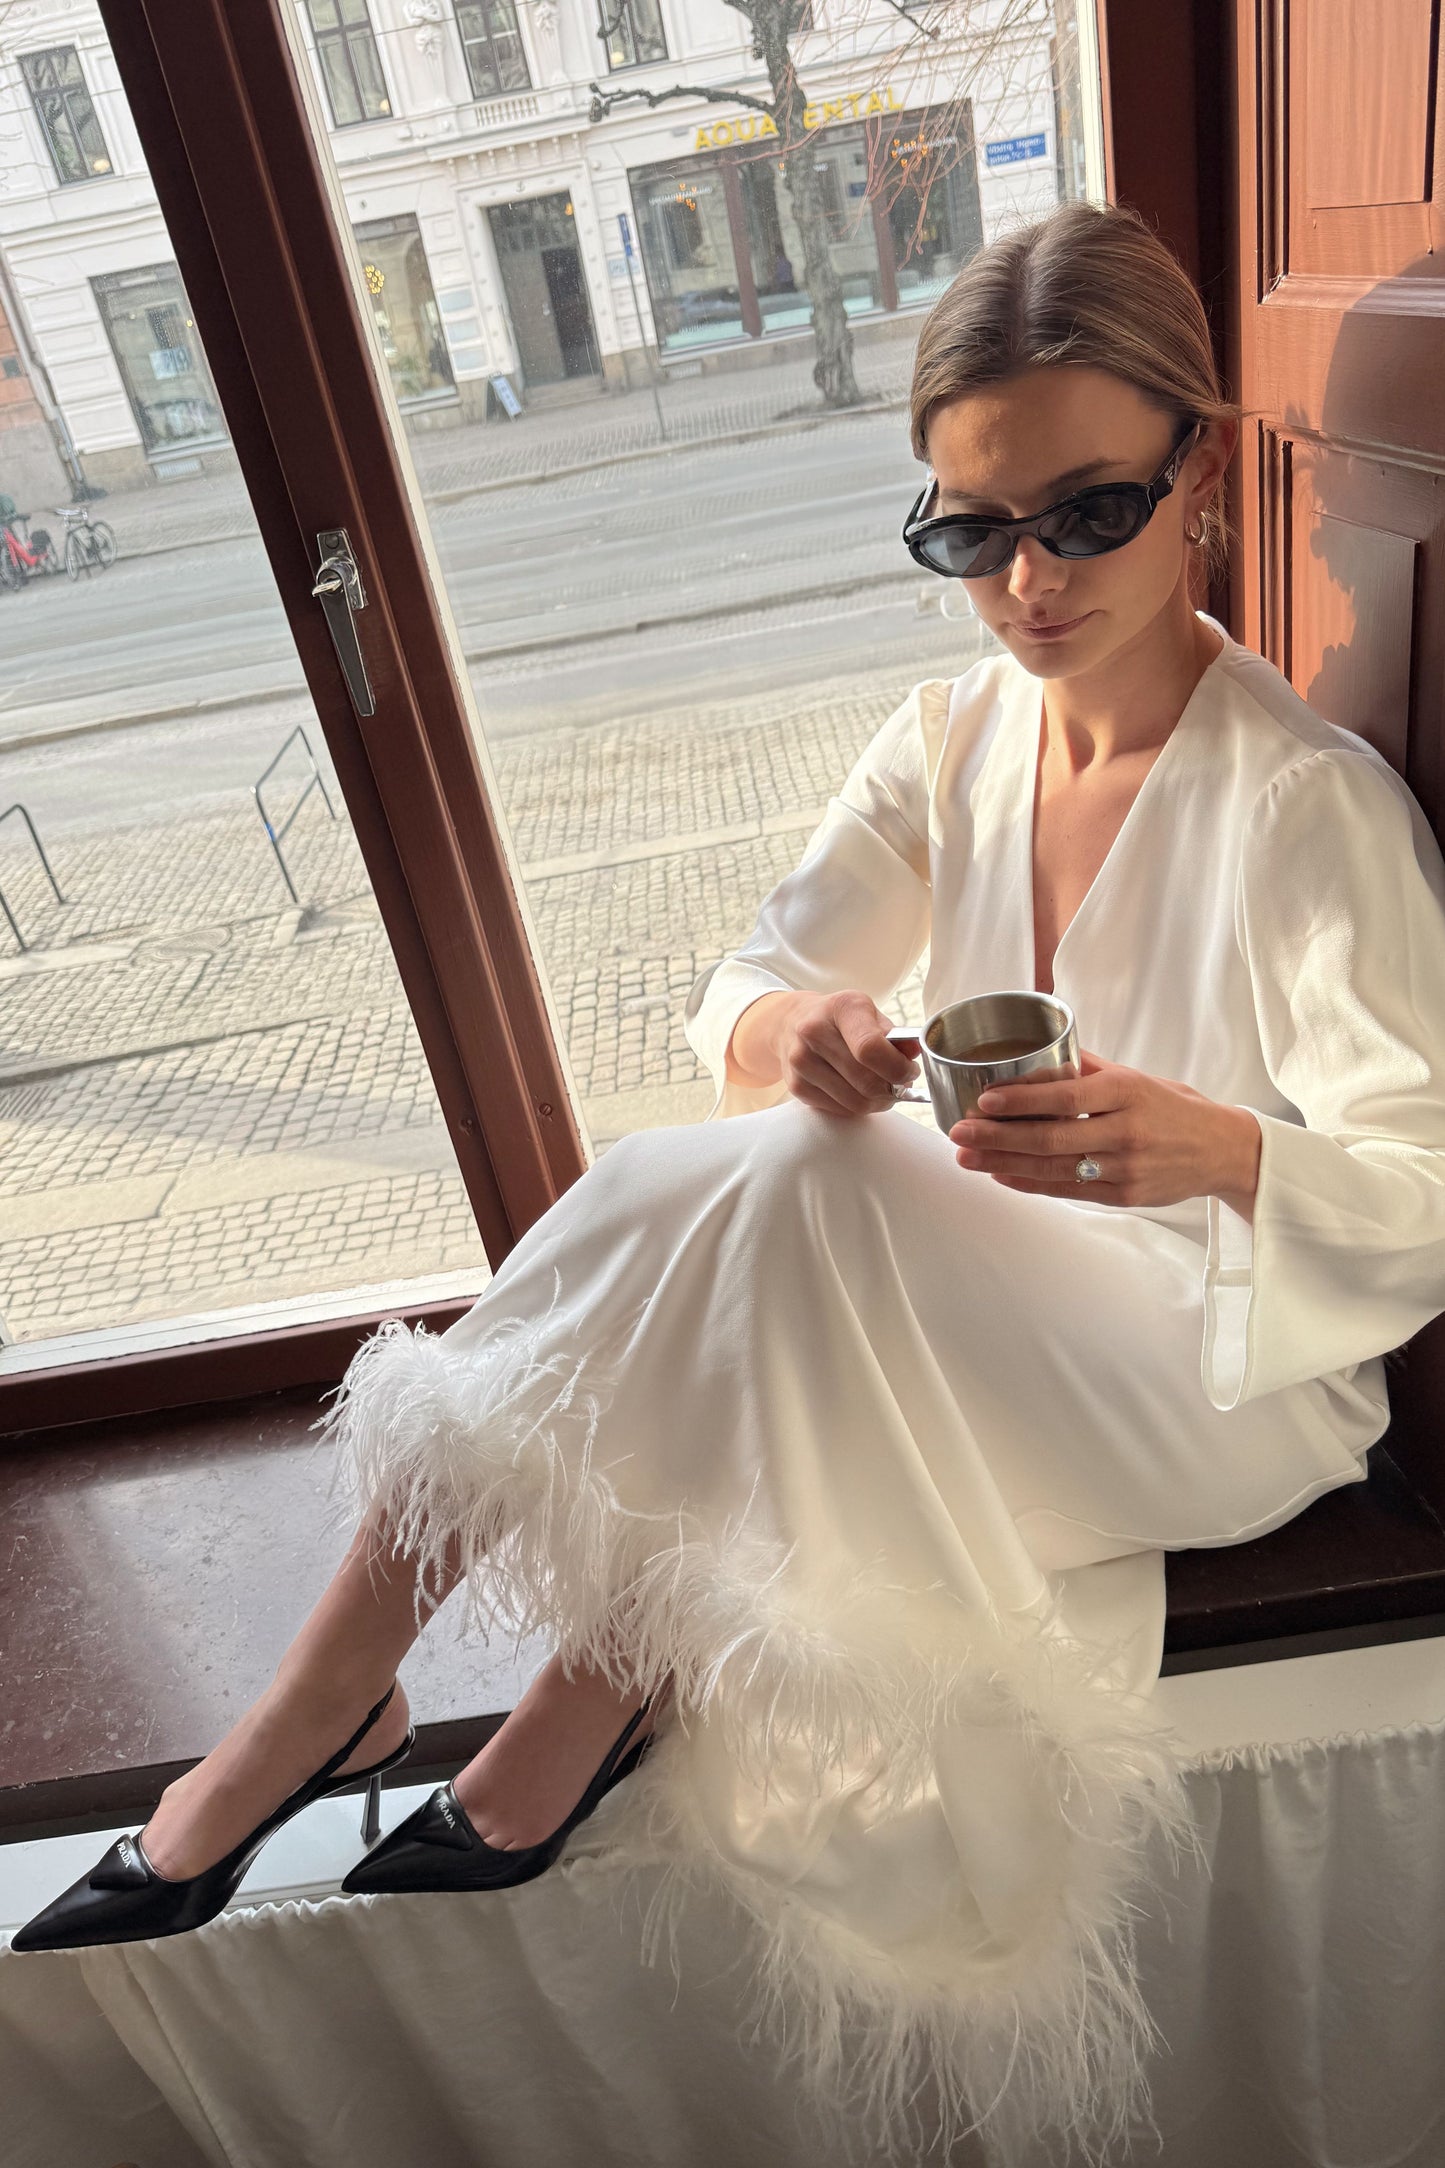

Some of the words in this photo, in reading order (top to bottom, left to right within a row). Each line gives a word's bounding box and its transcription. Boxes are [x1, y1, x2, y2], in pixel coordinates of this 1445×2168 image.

[695, 86, 903, 149] AQUAENTAL
[436, 1797, 456, 1829] PRADA
[117, 1842, 132, 1868] PRADA
